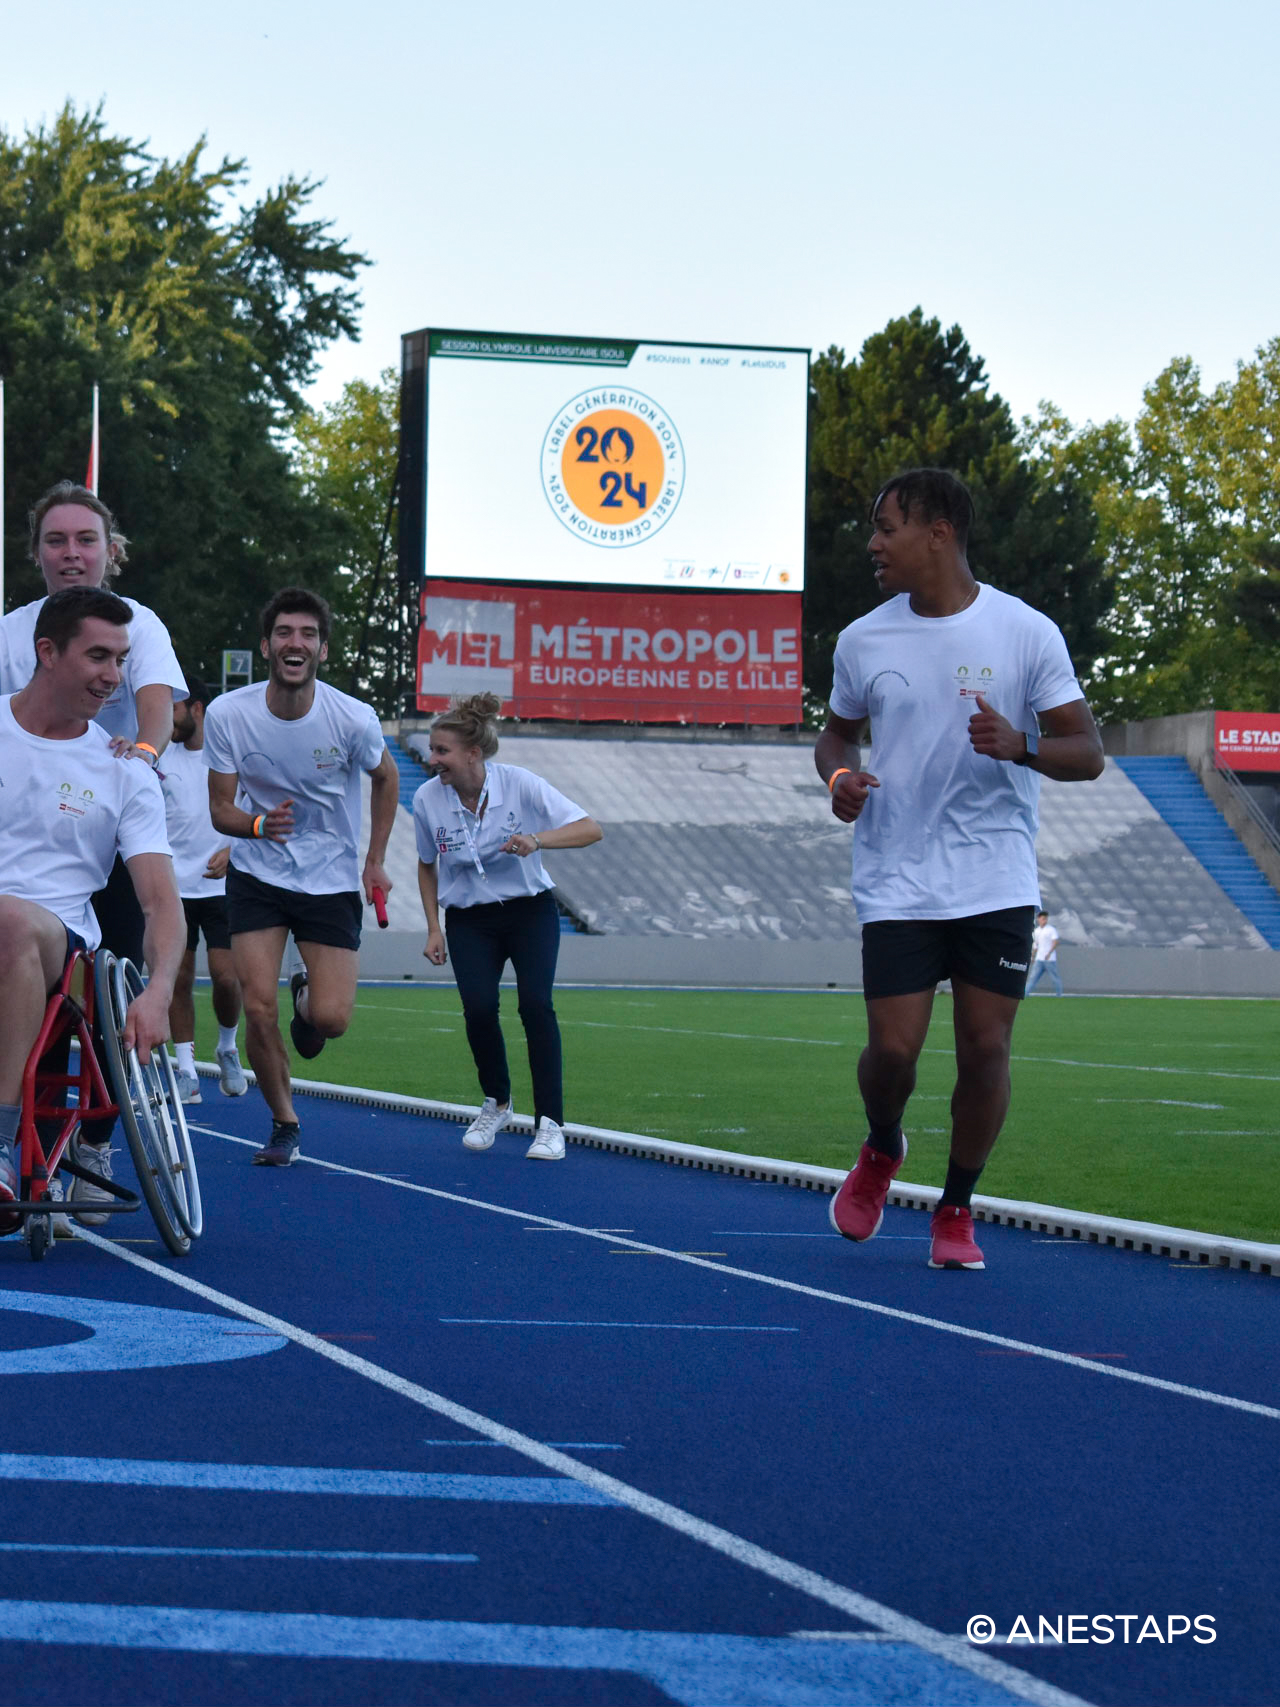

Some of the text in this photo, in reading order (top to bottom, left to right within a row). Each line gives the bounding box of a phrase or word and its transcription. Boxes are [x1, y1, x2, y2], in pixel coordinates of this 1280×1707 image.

[441, 339, 479, 350] SESSION
[481, 341, 531, 354] OLYMPIQUE
[534, 344, 597, 358] UNIVERSITAIRE
[549, 390, 677, 459] LABEL GÉNÉRATION 2024
[575, 426, 634, 464] 20
[549, 475, 677, 543] LABEL GÉNÉRATION 2024
[599, 470, 647, 509] 24
[423, 629, 513, 669] MEL
[531, 617, 798, 663] MÉTROPOLE
[530, 664, 798, 691] EUROPÉENNE DE LILLE
[1219, 729, 1280, 745] LE STAD
